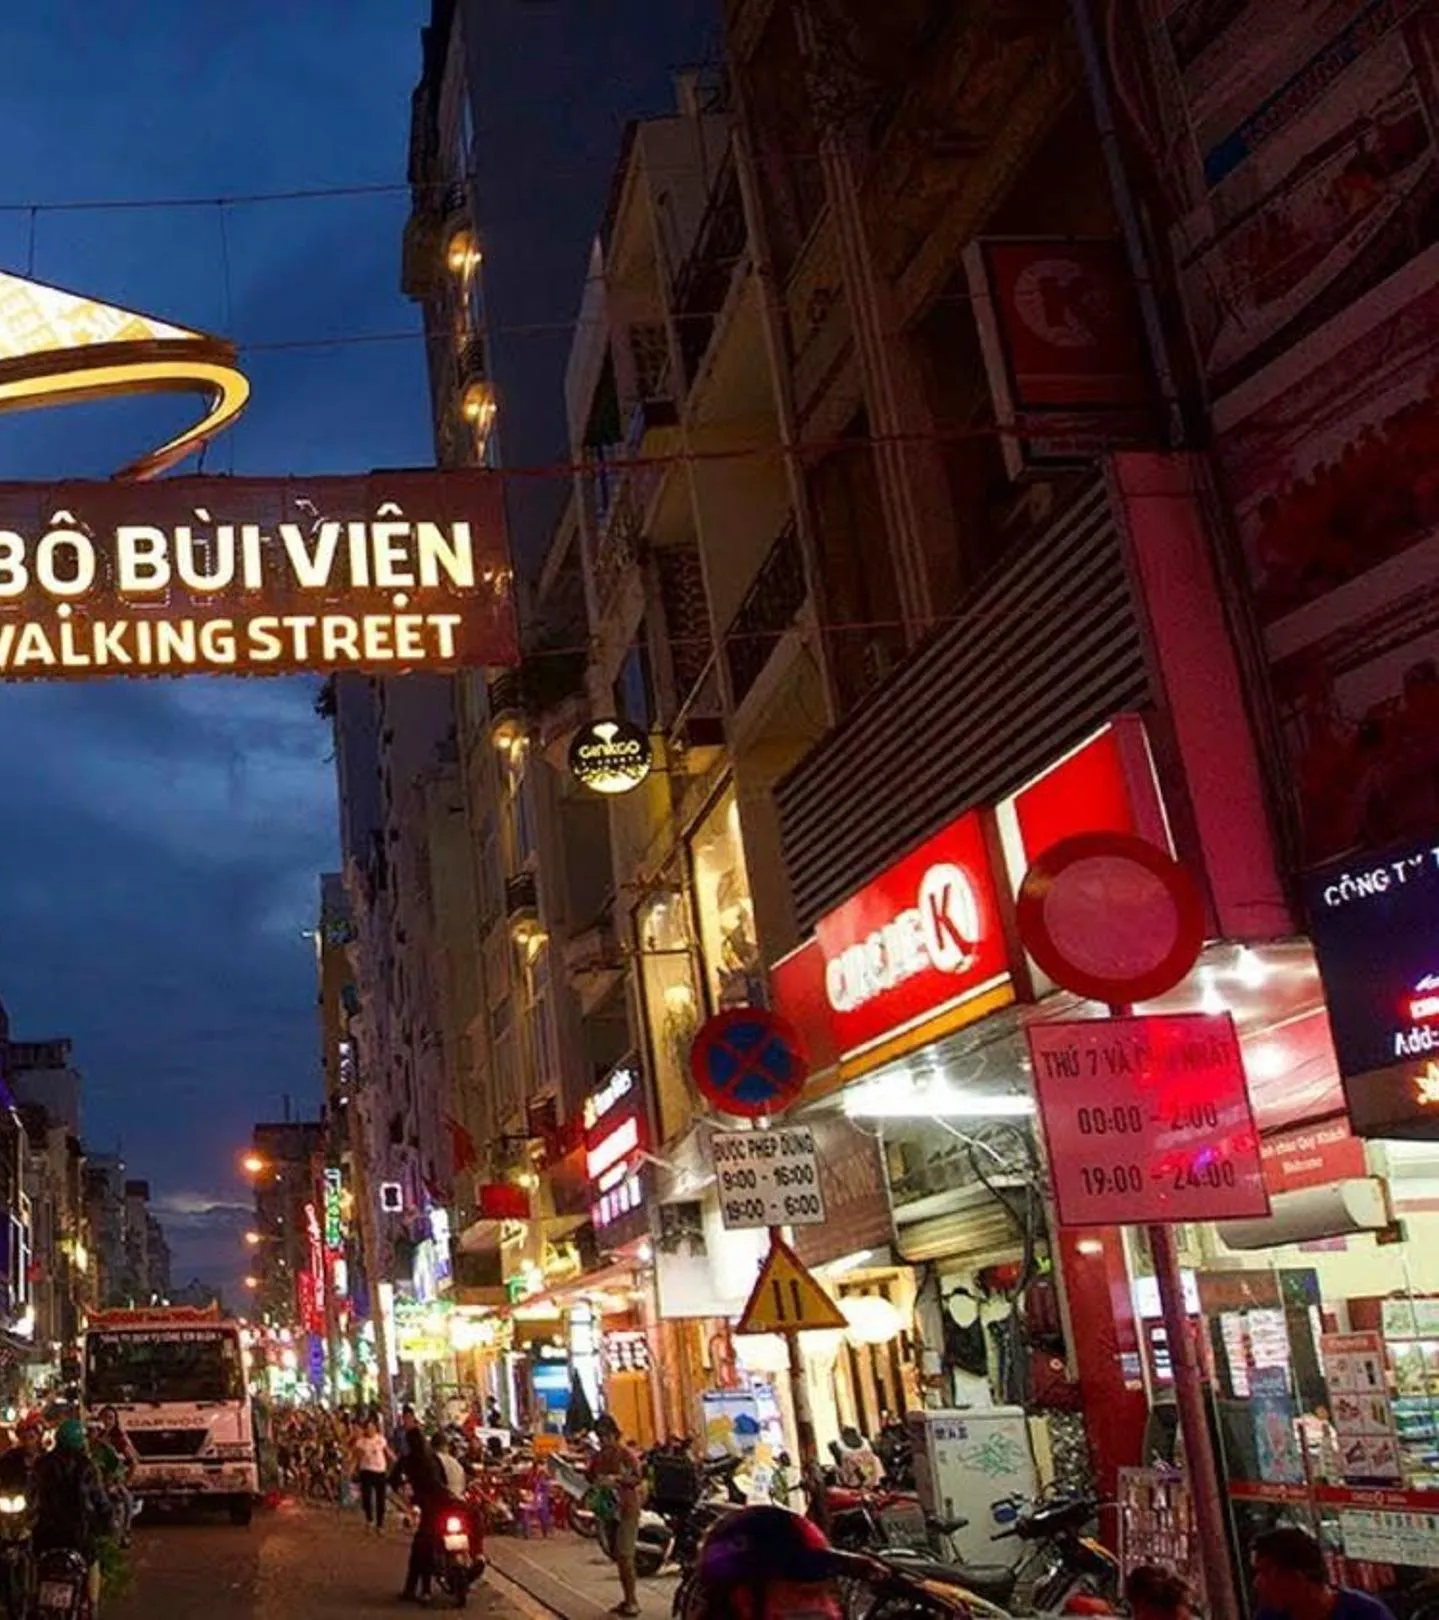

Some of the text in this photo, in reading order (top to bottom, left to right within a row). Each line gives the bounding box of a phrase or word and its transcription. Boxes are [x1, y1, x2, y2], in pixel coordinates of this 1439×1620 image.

[116, 508, 260, 592] BÙI
[278, 502, 475, 608] VIỆN
[247, 614, 461, 661] STREET
[1323, 868, 1392, 907] CÔNG
[1086, 1048, 1098, 1077] 7
[1103, 1040, 1134, 1075] VÀ
[1077, 1105, 1144, 1136] 00:00
[722, 1168, 757, 1191] 9:00
[773, 1163, 814, 1187] 16:00
[1082, 1165, 1144, 1196] 19:00
[784, 1194, 819, 1217] 6:00
